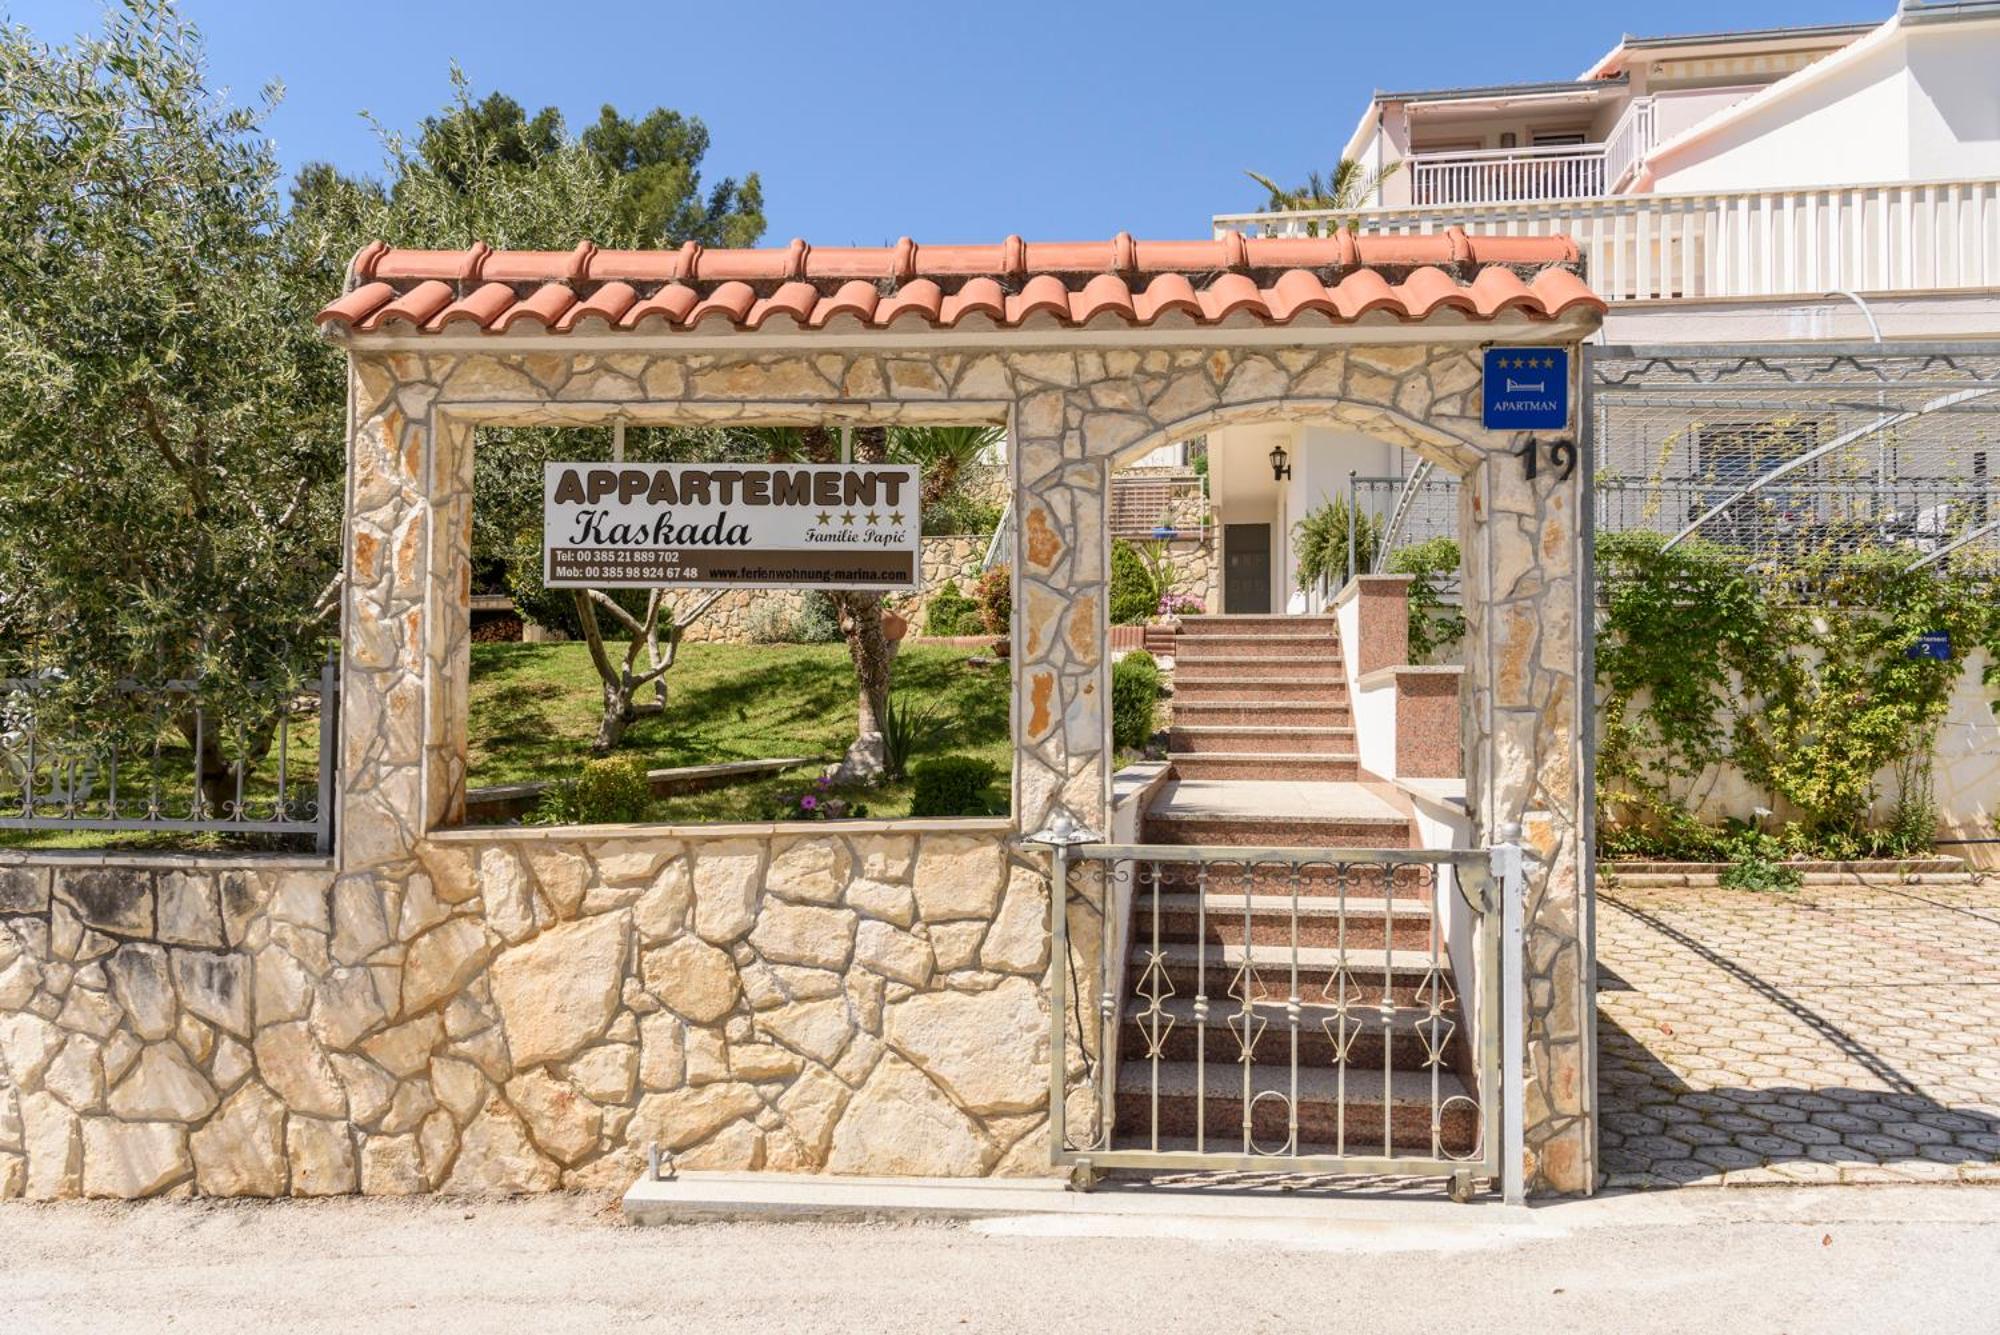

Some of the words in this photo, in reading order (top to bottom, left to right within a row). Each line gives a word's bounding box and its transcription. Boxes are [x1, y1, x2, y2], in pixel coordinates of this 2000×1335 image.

[1493, 401, 1557, 411] APARTMAN
[1514, 438, 1578, 481] 19
[554, 469, 910, 506] APPARTEMENT
[569, 510, 753, 545] Kaskada
[804, 528, 859, 543] Familie
[556, 551, 575, 562] Tel:
[576, 551, 592, 562] 00
[593, 551, 615, 562] 385
[617, 551, 633, 562] 21
[634, 551, 655, 562] 889
[658, 551, 680, 562] 702
[556, 566, 583, 578] Mob:
[585, 566, 600, 578] 00
[601, 566, 624, 578] 385
[626, 566, 641, 578] 98
[643, 566, 664, 578] 924
[666, 566, 681, 578] 67
[682, 566, 699, 578] 48
[709, 566, 907, 581] www.ferienwohnung-marina.com
[1921, 643, 1931, 655] 2
